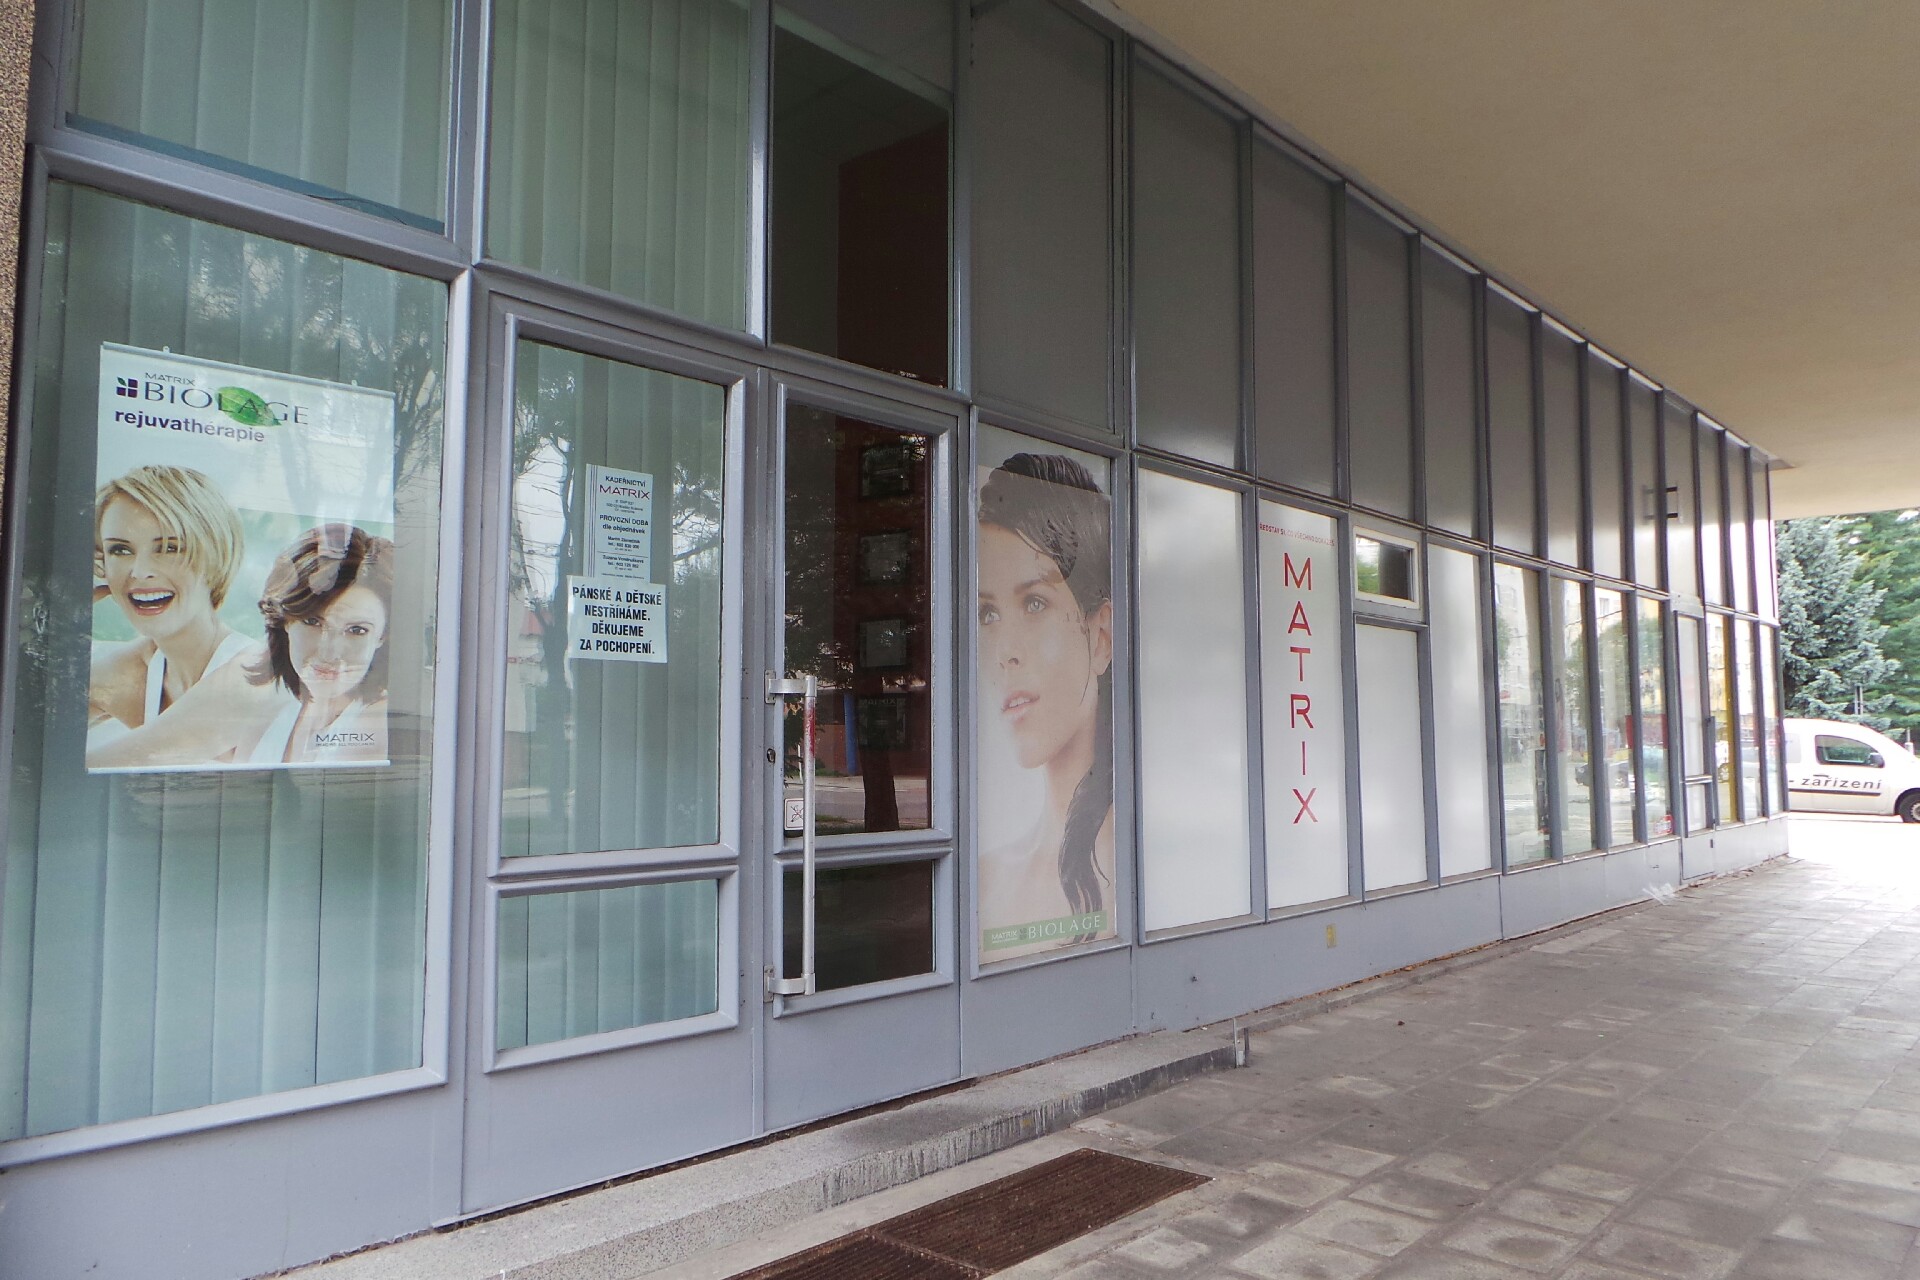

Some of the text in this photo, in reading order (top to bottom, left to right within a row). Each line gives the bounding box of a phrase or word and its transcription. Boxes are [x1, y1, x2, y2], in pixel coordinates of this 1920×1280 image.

[145, 372, 196, 387] MATRIX
[144, 381, 309, 426] BIOLAGE
[114, 410, 265, 442] rejuvathérapie
[599, 484, 650, 500] MATRIX
[599, 514, 649, 526] PROVOZNÍ DOBA
[612, 525, 646, 534] objednávek
[572, 584, 662, 605] PÁNSKÉ A DĚTSKÉ
[584, 603, 651, 621] NESTŘÍHÁME.
[592, 620, 644, 637] DĚKUJEME
[579, 639, 655, 654] ZA POCHOPENÍ.
[1284, 552, 1318, 824] MATRIX
[316, 733, 374, 742] MATRIX
[992, 915, 1101, 940] MATRIX BIOLAGE
